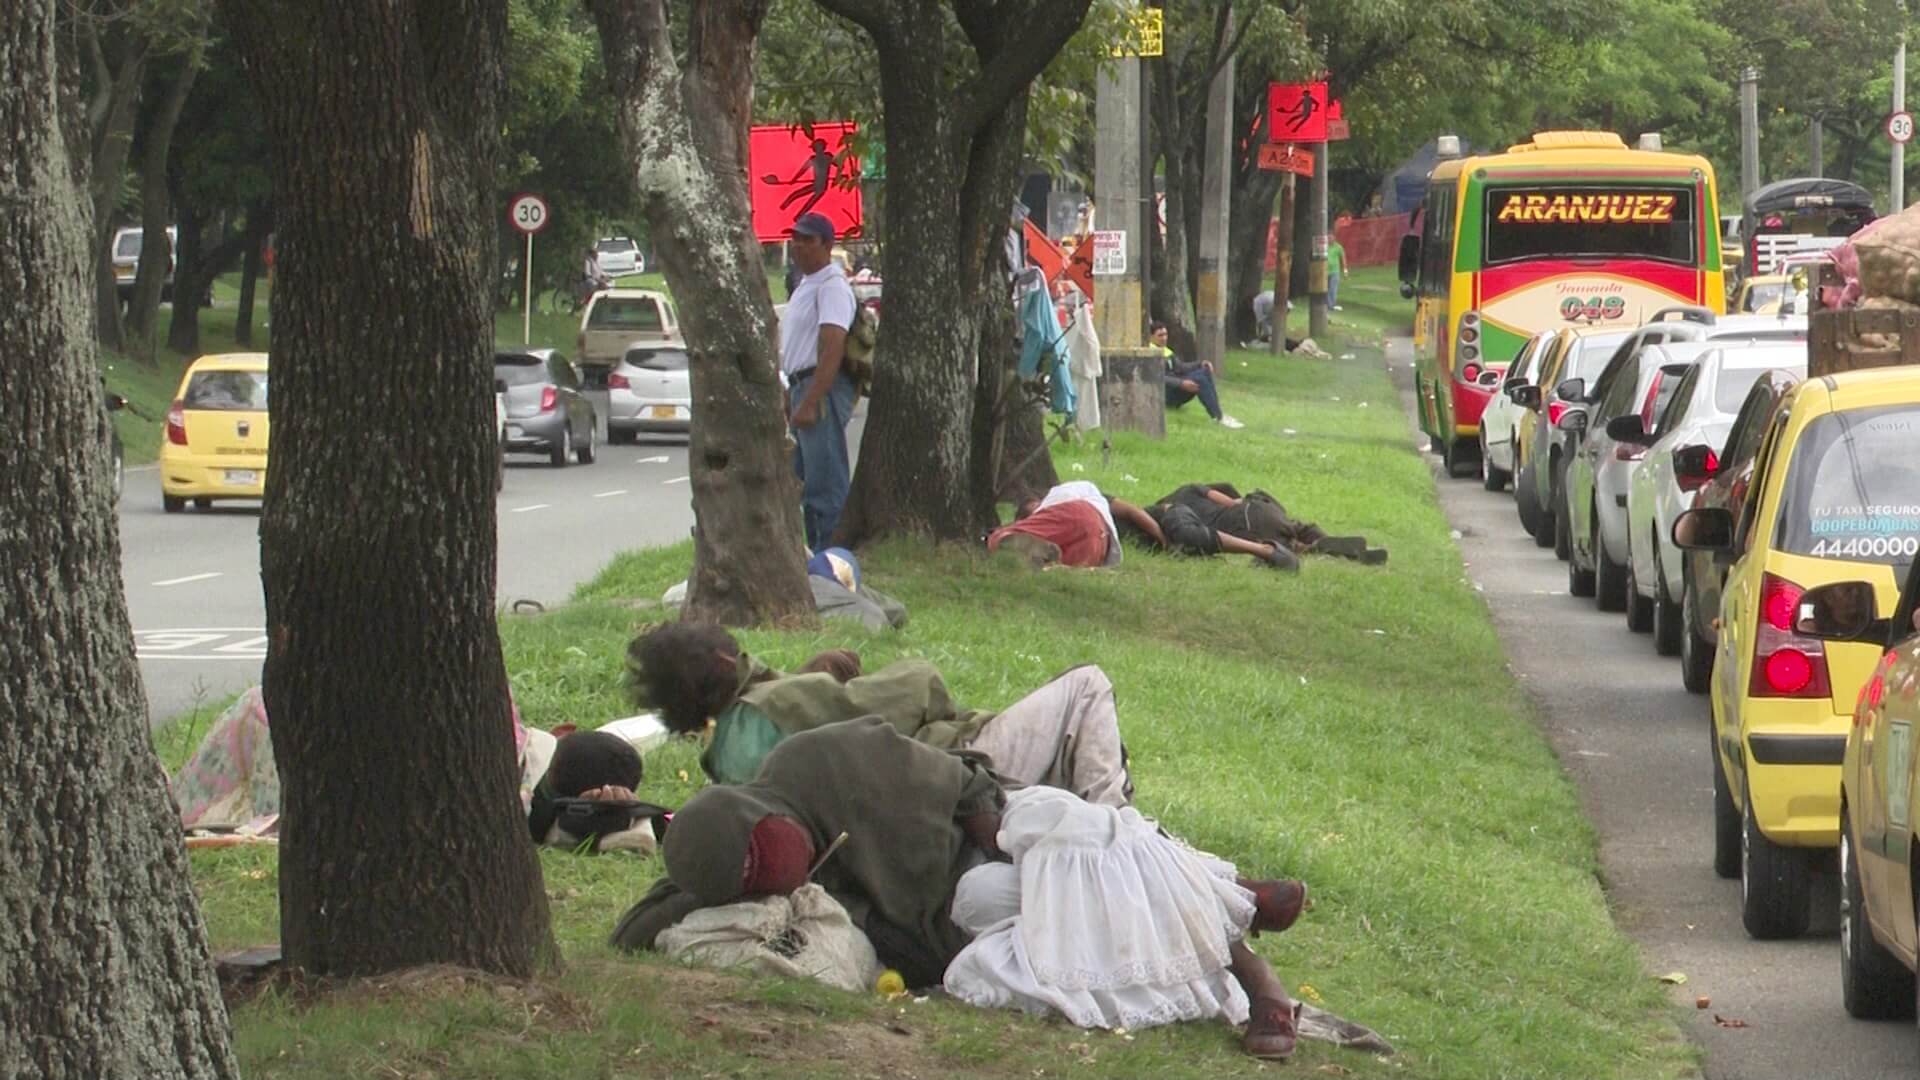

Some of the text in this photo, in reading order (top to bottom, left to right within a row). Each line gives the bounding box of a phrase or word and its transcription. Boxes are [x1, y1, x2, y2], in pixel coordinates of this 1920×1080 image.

[1893, 120, 1910, 135] 30
[519, 205, 541, 222] 30
[1497, 194, 1676, 223] ARANJUEZ
[1559, 296, 1625, 320] 048
[1814, 504, 1920, 517] TU TAXI SEGURO
[1809, 537, 1919, 558] 4440000
